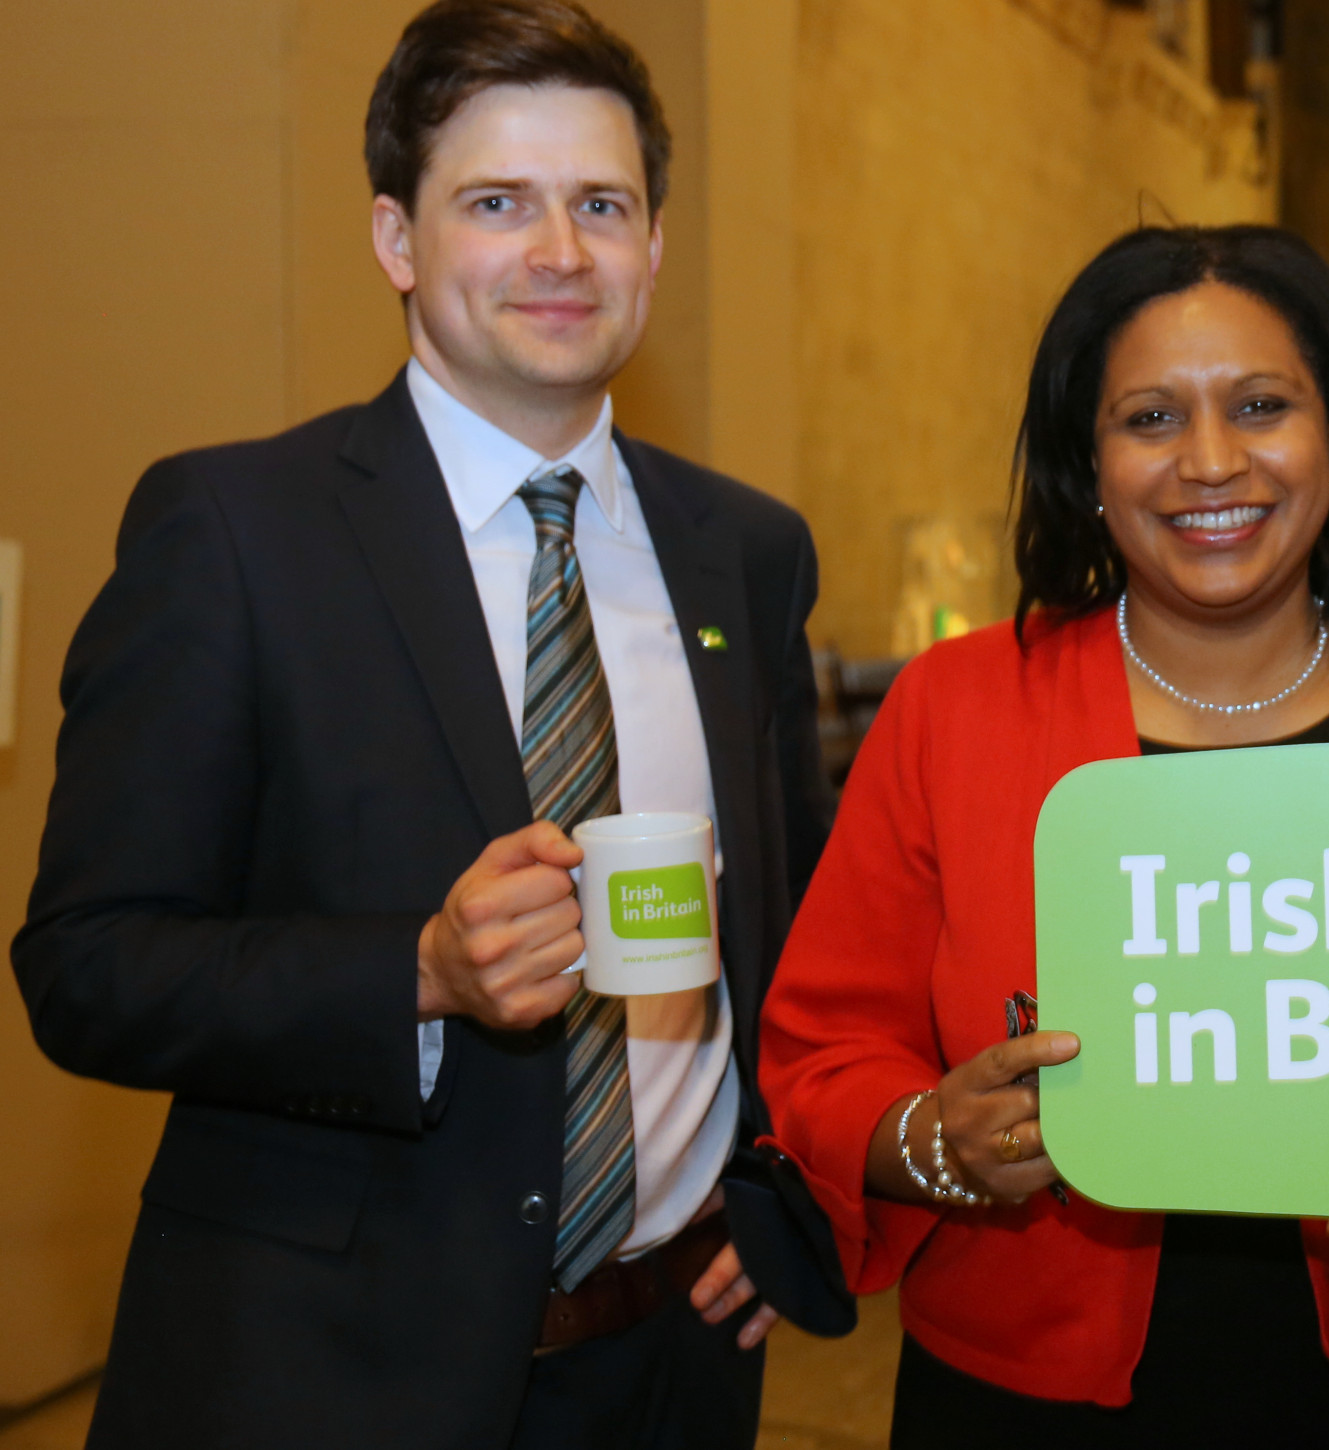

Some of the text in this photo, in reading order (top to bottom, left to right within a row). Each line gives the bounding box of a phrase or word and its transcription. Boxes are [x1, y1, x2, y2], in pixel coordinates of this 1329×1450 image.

[620, 883, 664, 903] Irish
[623, 897, 702, 921] in Britain
[1133, 982, 1238, 1084] in
